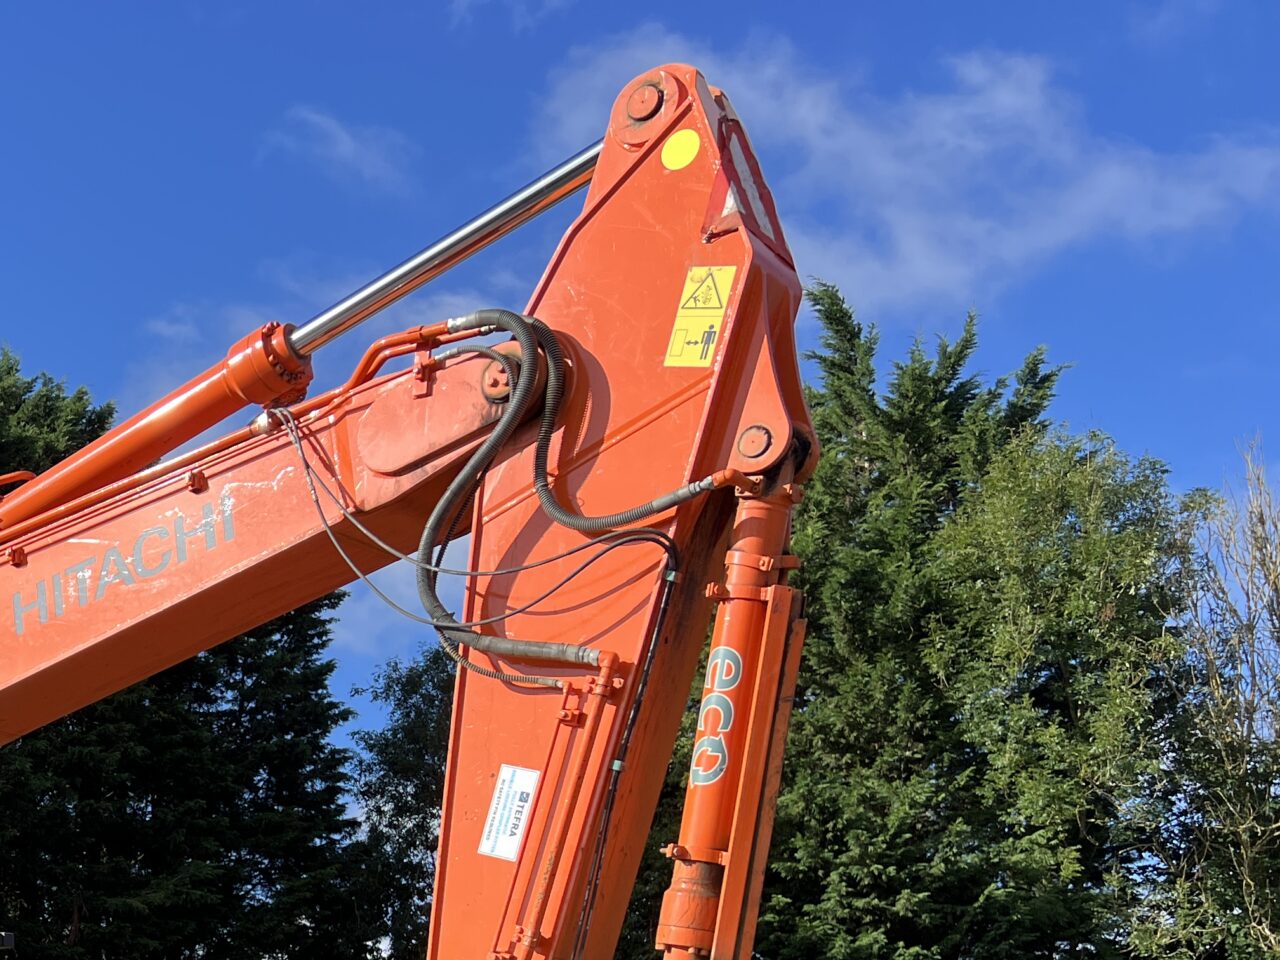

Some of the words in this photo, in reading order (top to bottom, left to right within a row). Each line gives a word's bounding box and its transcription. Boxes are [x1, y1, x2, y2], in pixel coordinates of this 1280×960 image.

[12, 495, 235, 636] HITACHI
[691, 646, 743, 787] eco
[509, 804, 524, 837] TEFRA
